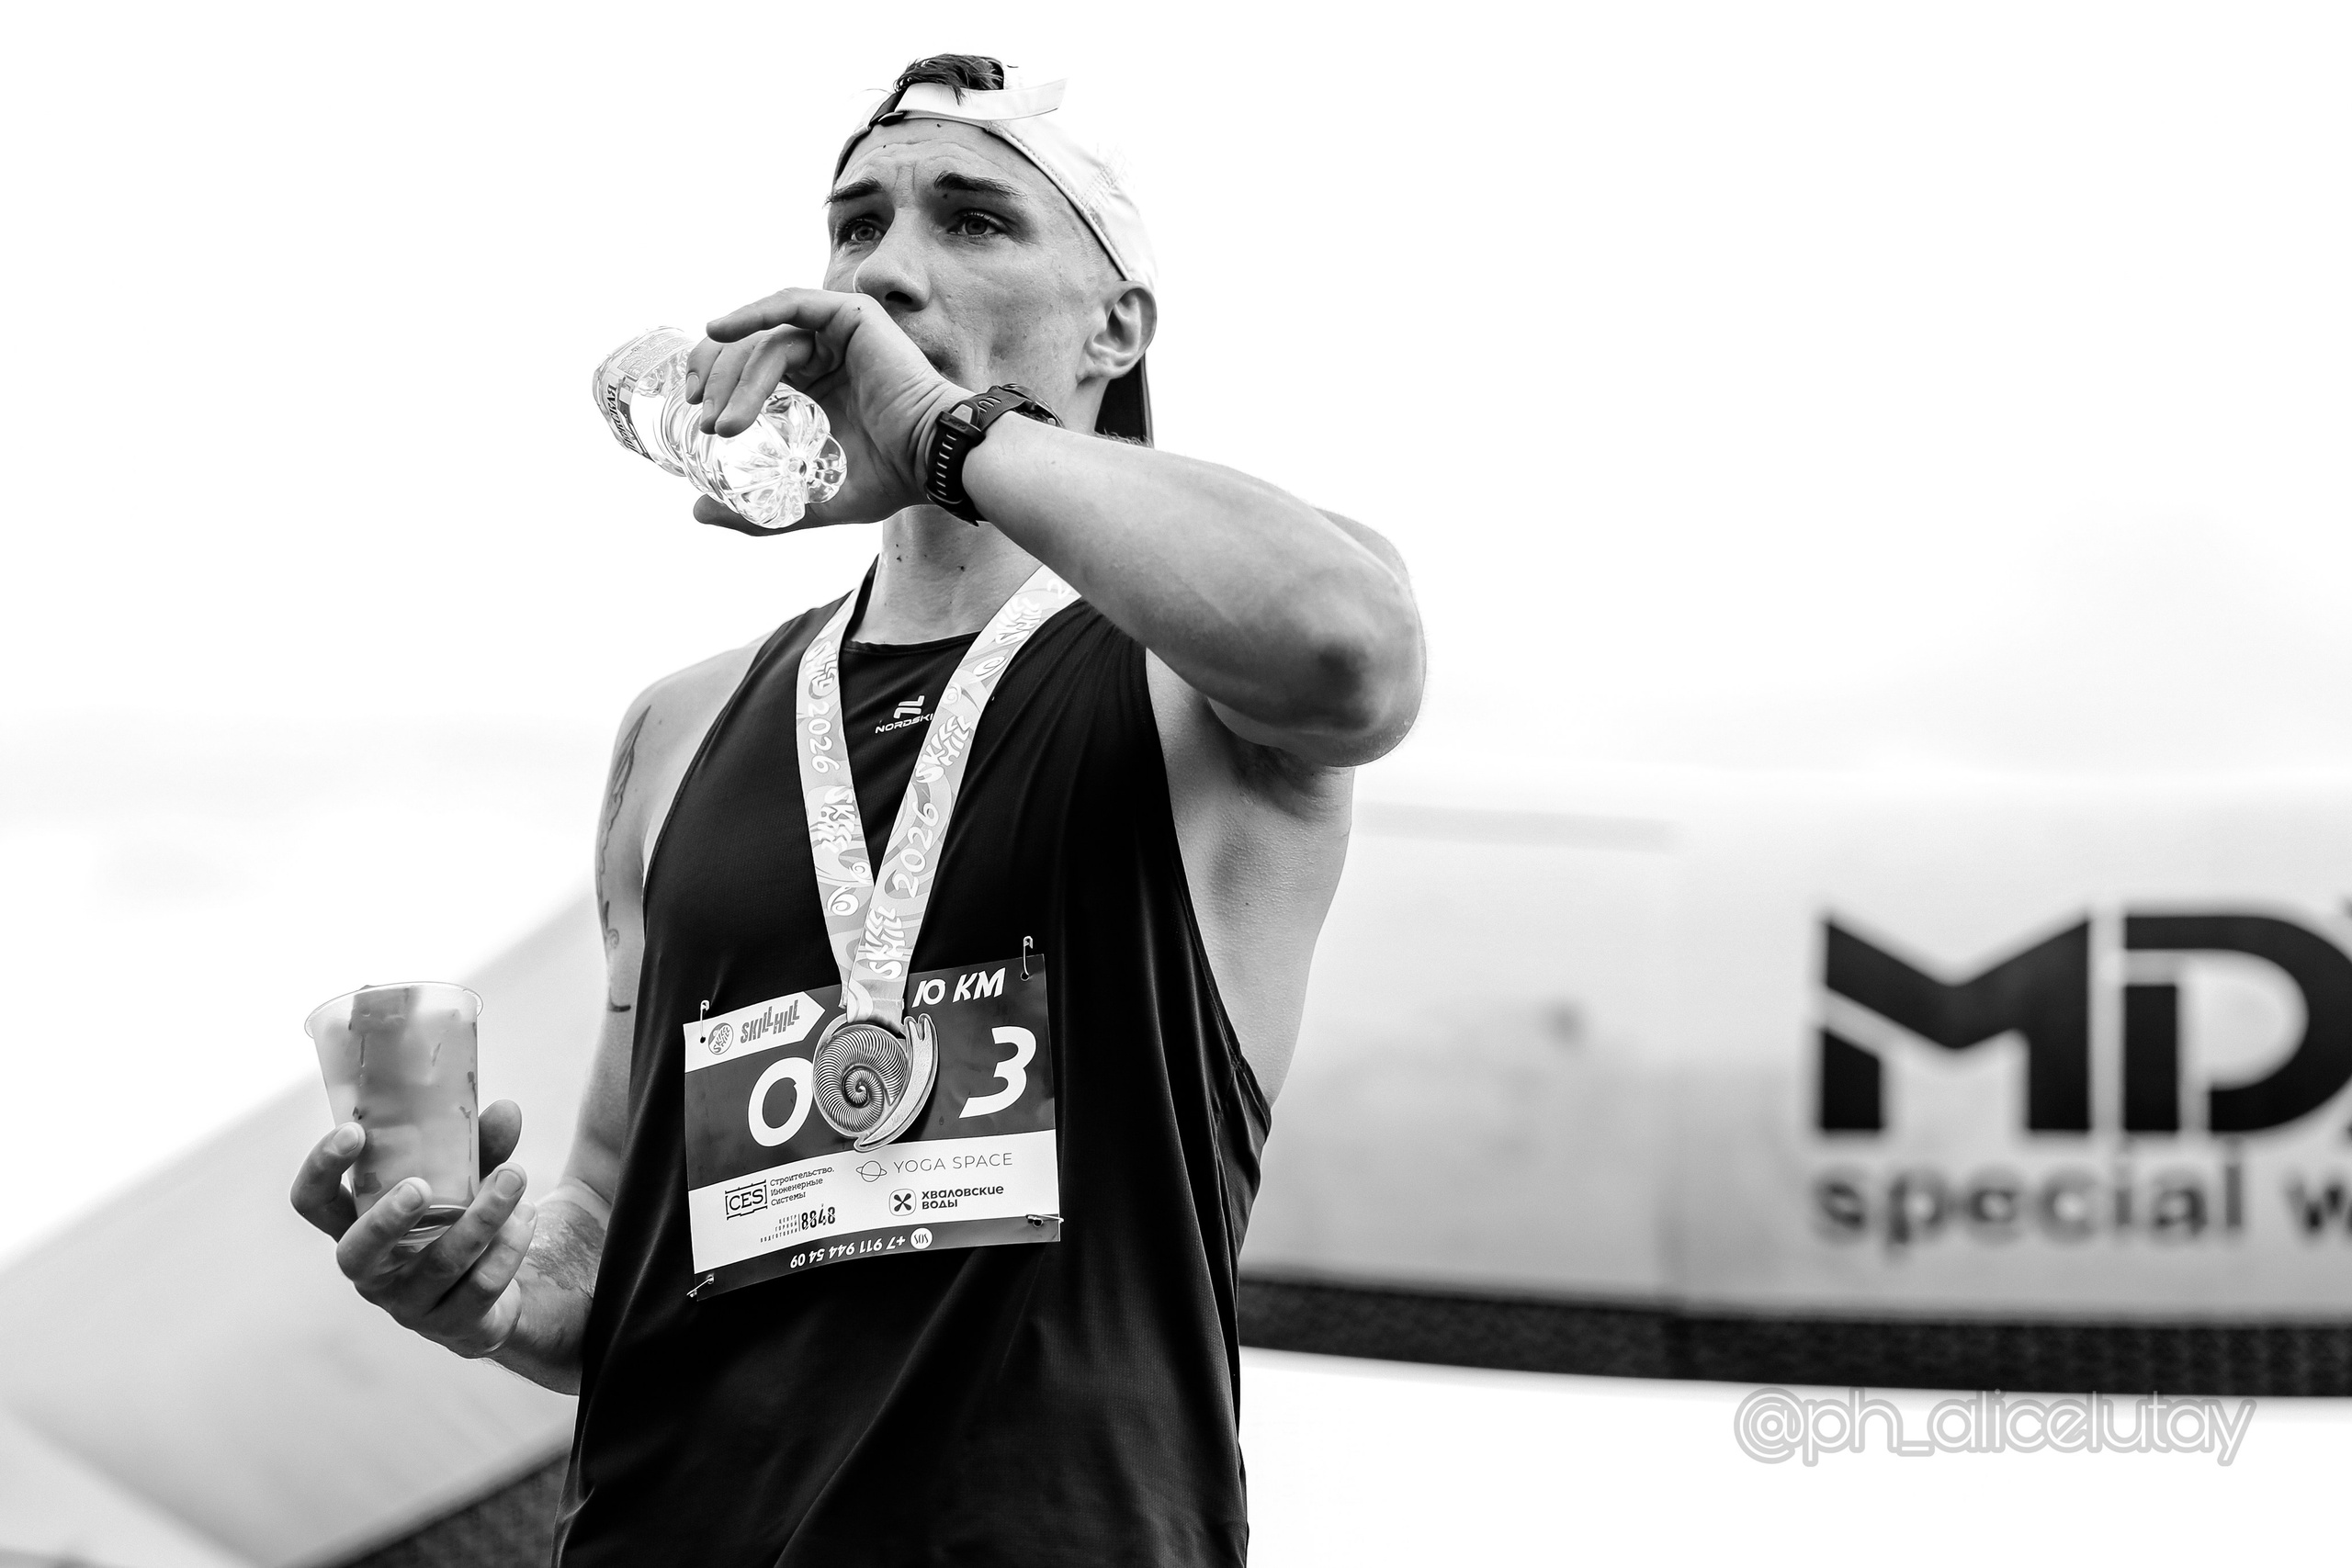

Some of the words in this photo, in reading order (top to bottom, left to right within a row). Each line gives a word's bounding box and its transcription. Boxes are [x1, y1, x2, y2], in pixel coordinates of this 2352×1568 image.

[875, 713, 934, 734] NORDSKI
[808, 701, 841, 773] 2026
[891, 801, 940, 898] 2026
[910, 978, 945, 1009] 10
[952, 967, 1006, 1003] KM
[1815, 911, 2352, 1137] MD
[893, 1157, 946, 1174] YOGA
[952, 1152, 1013, 1169] SPACE
[770, 1178, 823, 1197] Инженерные
[729, 1189, 764, 1211] CES
[1812, 1153, 2244, 1258] special
[801, 1204, 836, 1231] 8848
[828, 1242, 855, 1259] 944
[859, 1238, 883, 1254] 911
[886, 1235, 906, 1250] +7
[789, 1253, 807, 1269] 09
[808, 1248, 826, 1264] 54
